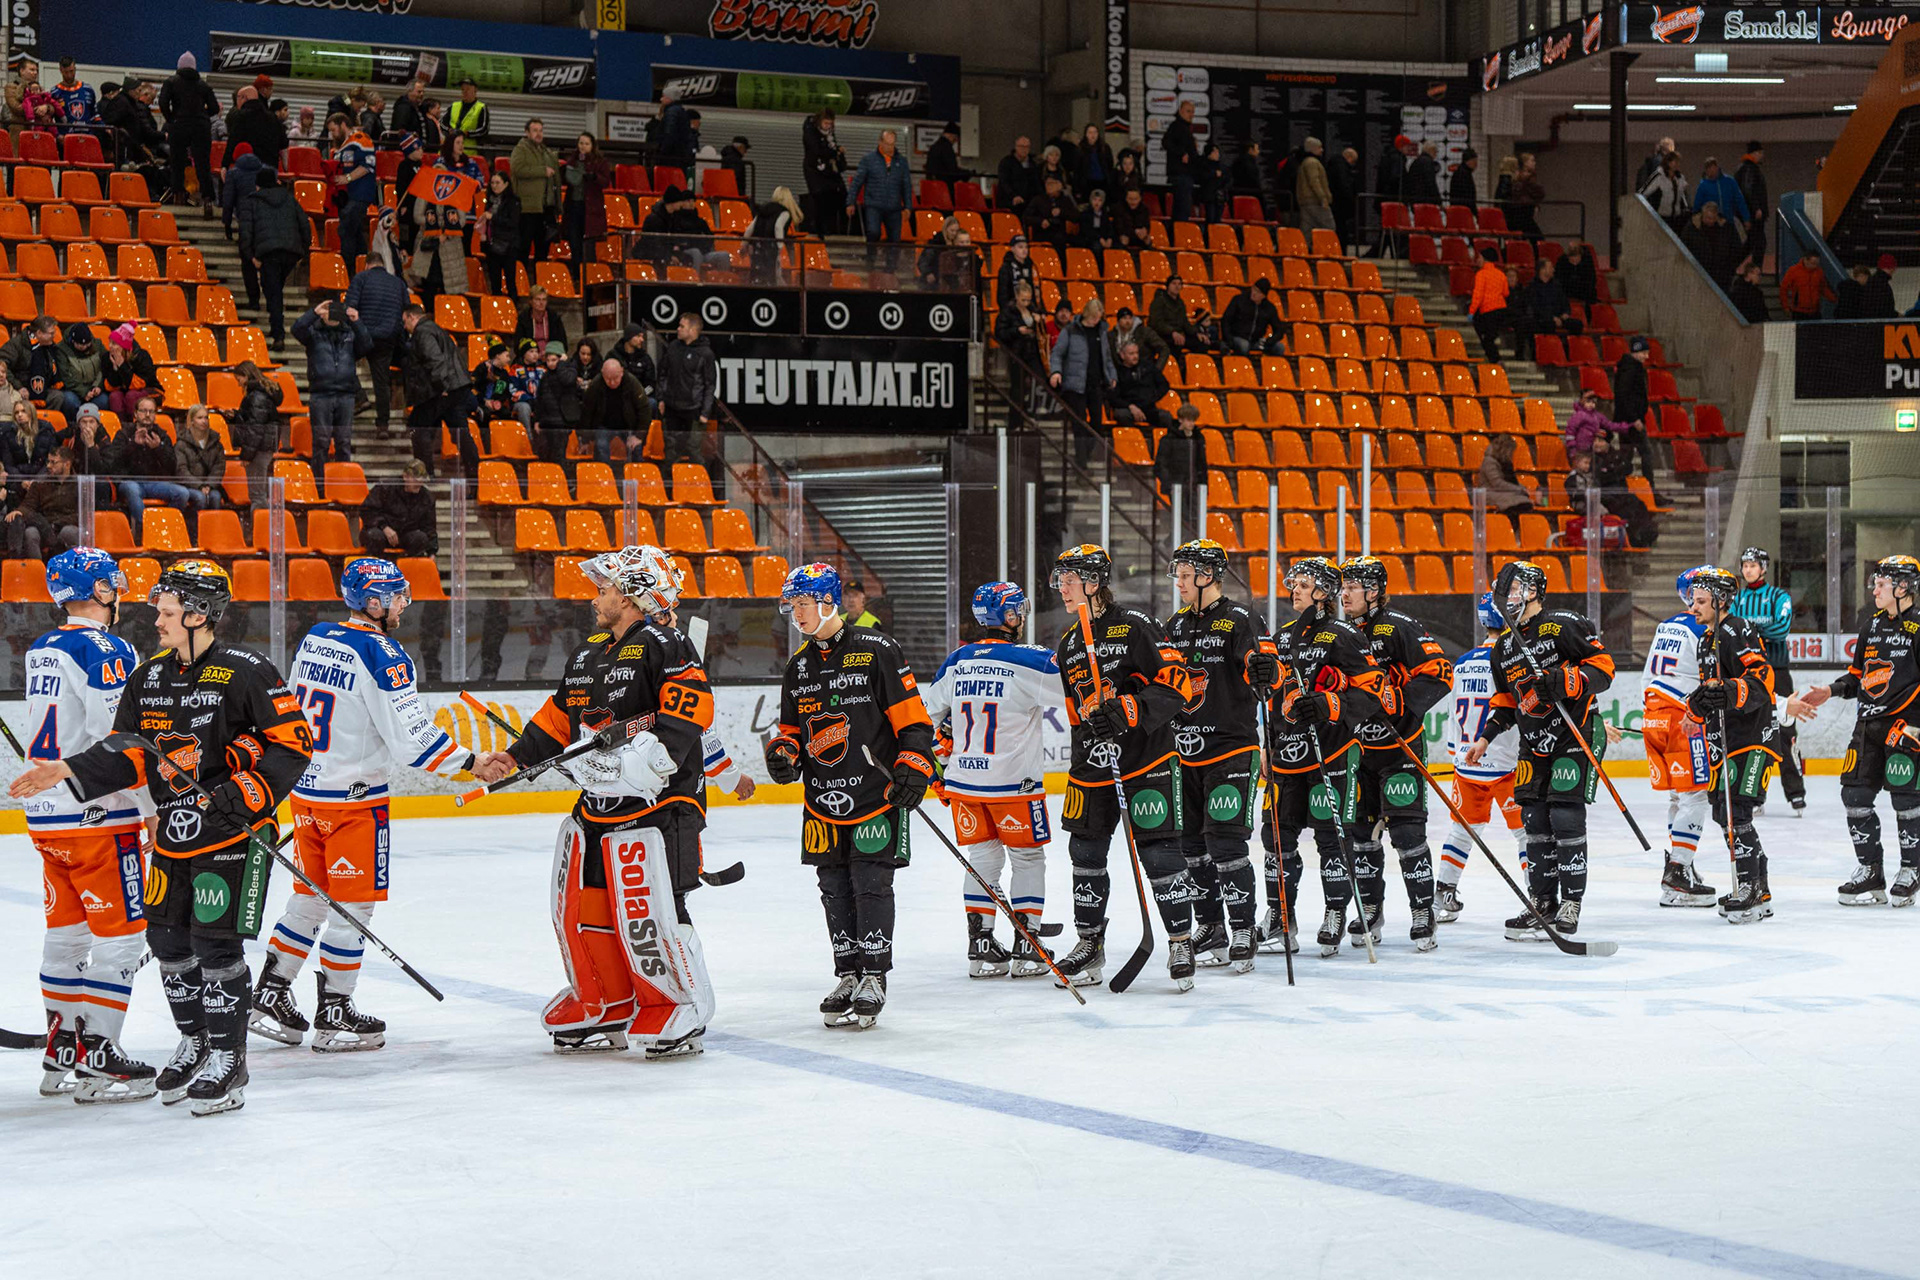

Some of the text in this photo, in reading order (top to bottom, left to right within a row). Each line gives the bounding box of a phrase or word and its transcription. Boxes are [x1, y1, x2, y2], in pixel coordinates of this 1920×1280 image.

[13, 0, 37, 46] o.fi
[1724, 9, 1819, 40] Sandels
[1831, 10, 1908, 41] Lounge
[221, 43, 280, 68] TEHO
[532, 64, 586, 89] TEHO
[868, 88, 917, 111] TEHO
[713, 357, 954, 409] TEUTTAJAT.FI
[618, 647, 644, 658] GRANO
[1787, 636, 1823, 658] ilä
[842, 655, 873, 667] GRANO
[102, 658, 127, 685] 44
[386, 663, 411, 689] 33
[1168, 667, 1188, 691] 17
[829, 674, 869, 691] HÖYRY
[954, 680, 1004, 698] CAMPER
[1461, 678, 1488, 693] TANUS
[663, 686, 700, 720] 32
[797, 701, 823, 714] SORT
[839, 694, 872, 706] Lasipack
[190, 712, 214, 729] TEHO
[408, 718, 429, 737] VISTA
[960, 701, 998, 755] 11
[1455, 697, 1491, 743] 27
[958, 759, 989, 770] MARI
[1691, 739, 1708, 783] Sievi
[1887, 763, 1911, 776] MM
[826, 775, 864, 789] AUTO OY
[1552, 768, 1577, 781] MM
[1745, 754, 1761, 795] AHA-Best
[1386, 782, 1416, 796] MM
[1133, 800, 1165, 816] MM
[1209, 796, 1238, 811] MM
[1323, 774, 1345, 839] BAUER
[855, 824, 888, 840] MM
[213, 853, 247, 861] BAUER
[377, 827, 389, 888] Sievi
[327, 868, 365, 876] POHJOLA
[1557, 861, 1585, 872] FoxRail
[122, 853, 144, 919] Sievi
[245, 849, 264, 930] AHA-Best Oy
[1155, 887, 1188, 902] FoxRail
[1442, 891, 1453, 905] 10
[976, 939, 990, 954] 10
[1019, 939, 1033, 954] 10
[259, 987, 278, 1008] 10
[326, 1006, 343, 1023] 10
[56, 1047, 75, 1066] 10
[86, 1049, 106, 1069] 10
